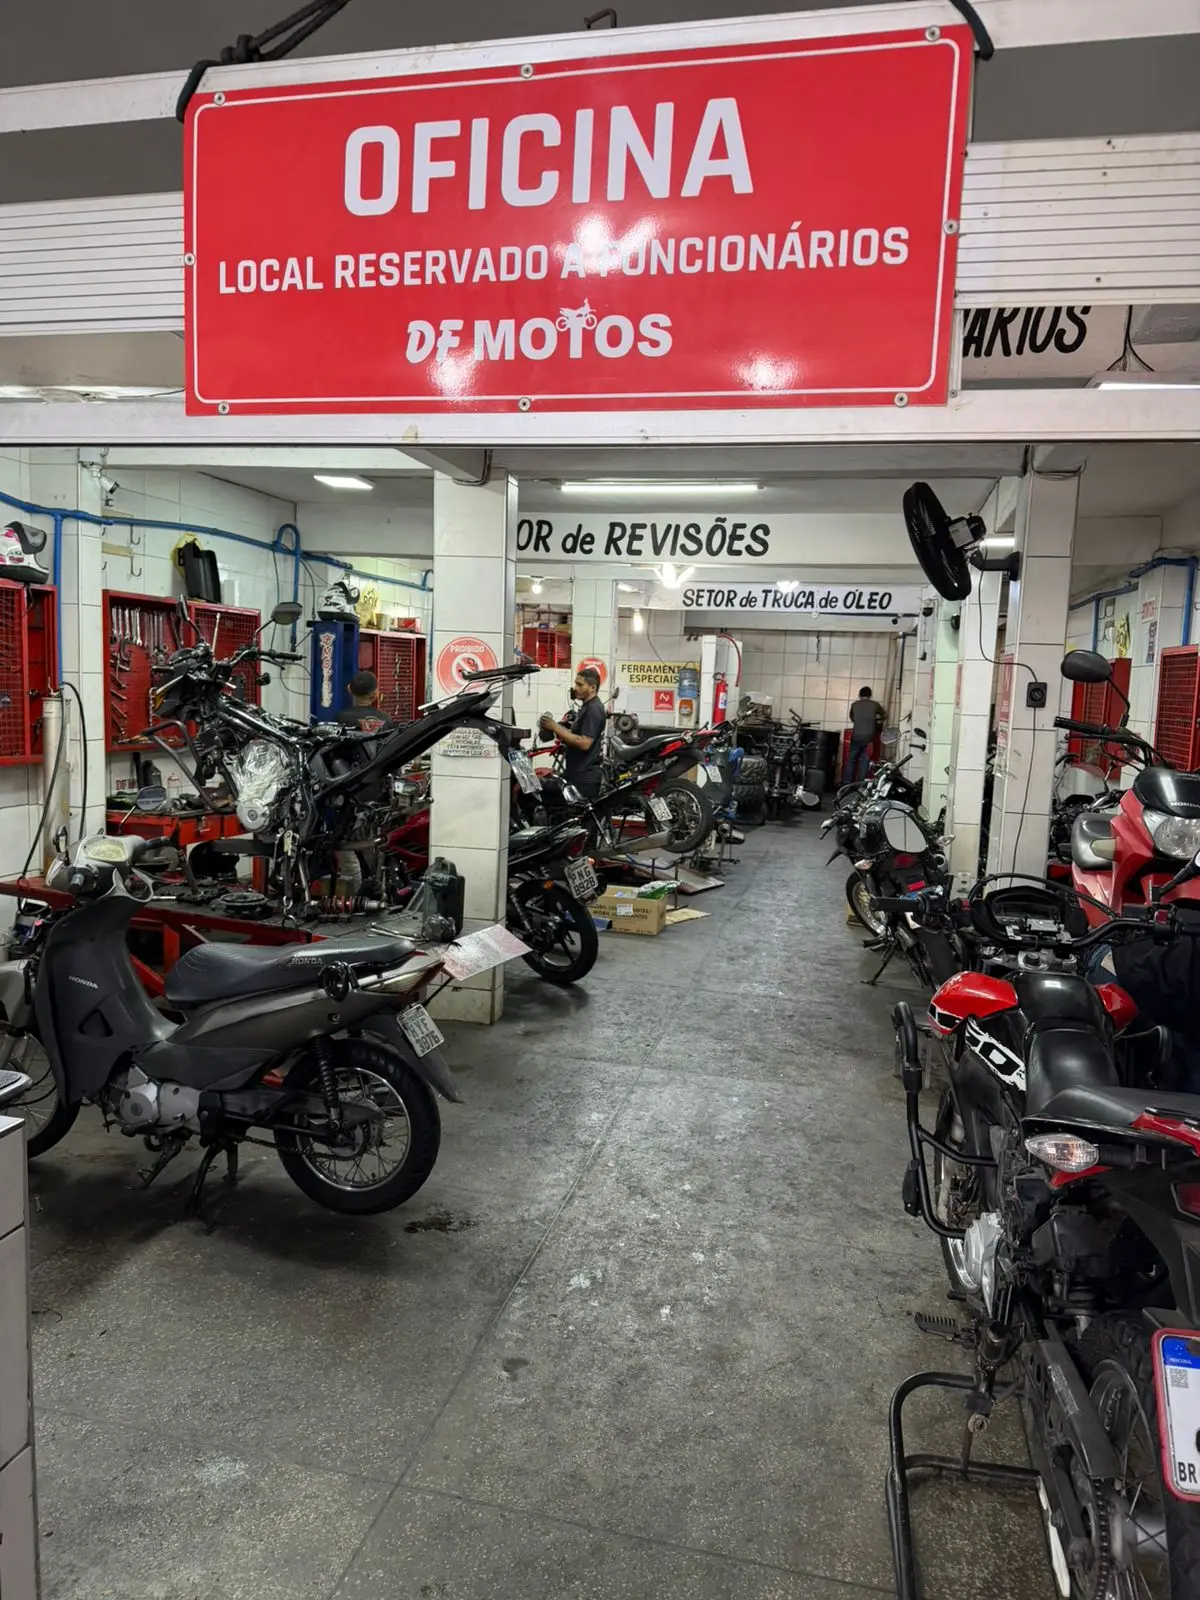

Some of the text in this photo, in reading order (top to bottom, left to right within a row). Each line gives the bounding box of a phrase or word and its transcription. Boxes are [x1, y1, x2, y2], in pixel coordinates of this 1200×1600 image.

[344, 97, 753, 217] OFICINA
[219, 257, 323, 293] LOCAL
[335, 245, 547, 288] RESERVADO
[560, 244, 586, 279] A
[473, 306, 672, 361] MOTOS
[517, 517, 770, 557] OR de REVISÕES
[683, 589, 893, 610] SETOR de TROCA de ÓLEO
[629, 674, 680, 684] ESPECIAIS
[69, 975, 98, 989] HONDA
[1178, 1462, 1198, 1484] BR
